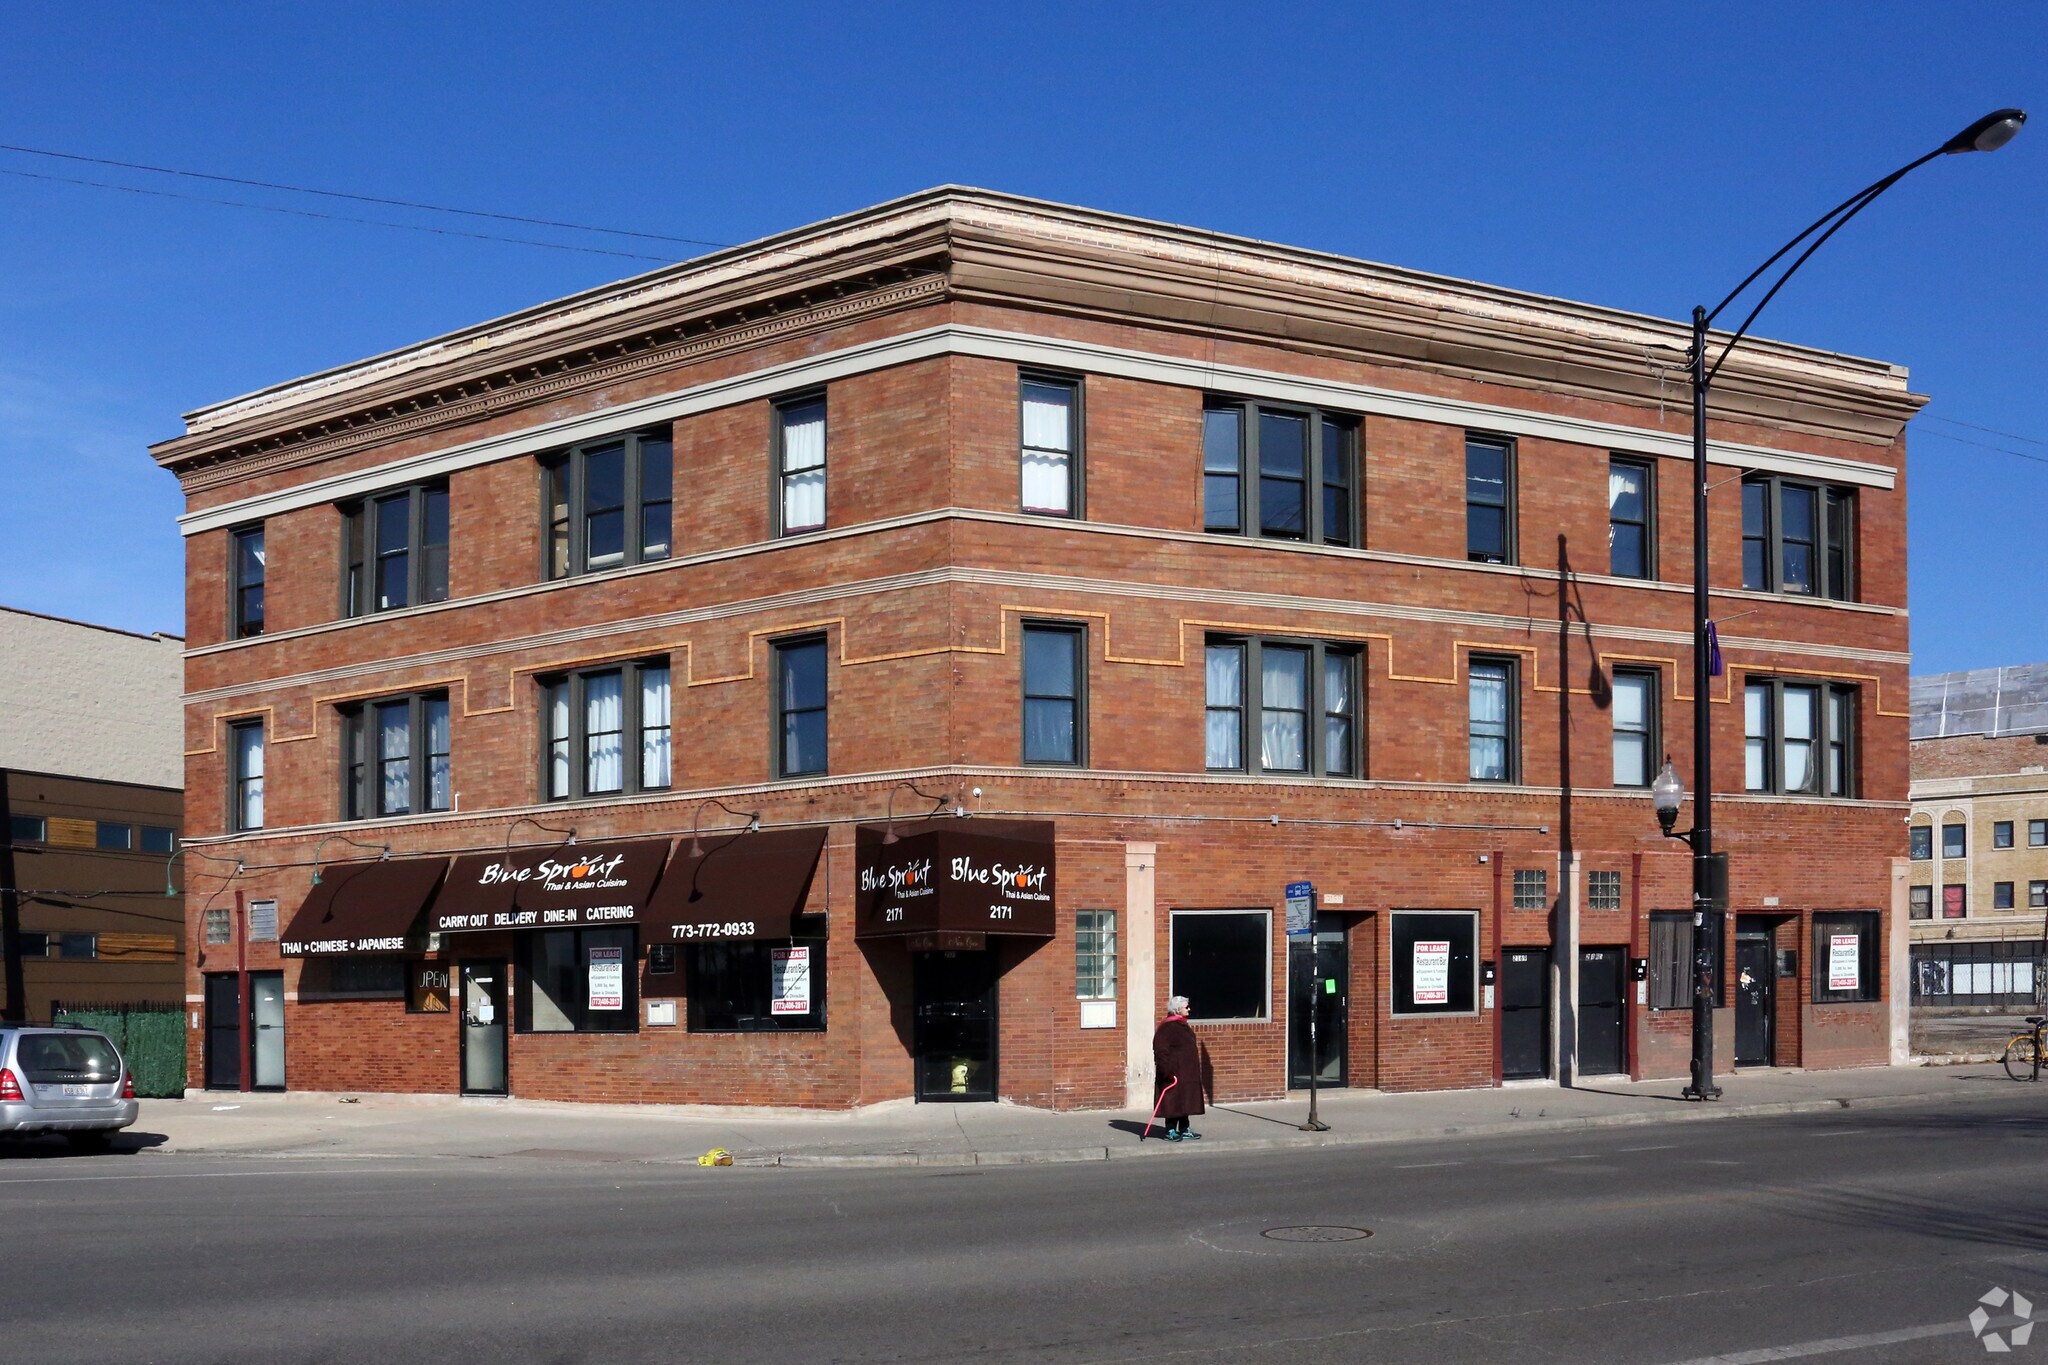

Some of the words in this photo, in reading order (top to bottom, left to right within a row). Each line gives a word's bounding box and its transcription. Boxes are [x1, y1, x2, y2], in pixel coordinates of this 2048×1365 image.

[478, 863, 532, 885] Blue
[533, 854, 624, 889] Sprout
[861, 866, 886, 891] Blue
[888, 858, 932, 896] Sprout
[950, 856, 990, 884] Blue
[991, 863, 1047, 896] Sprout
[546, 882, 565, 891] Thai
[565, 882, 570, 890] &
[571, 881, 595, 890] Asian
[596, 879, 628, 888] Cuisine
[897, 891, 905, 899] Thai
[909, 889, 919, 897] Asian
[920, 887, 934, 896] Cuisine
[1005, 890, 1016, 898] Thai
[1016, 891, 1020, 899] &
[1020, 892, 1033, 900] Asian
[1034, 893, 1050, 901] Cuisine
[439, 915, 468, 929] CARRY
[470, 914, 488, 927] OUT
[494, 911, 537, 925] DELIVERY
[544, 909, 577, 923] DINE-IN
[586, 906, 634, 921] CATERING
[886, 907, 903, 921] 2171
[989, 905, 1012, 919] 2171
[671, 922, 755, 938] 773-772-0933
[281, 942, 302, 954] THAI
[310, 940, 348, 953] CHINESE
[357, 937, 404, 950] JAPANESE
[603, 950, 620, 958] LEASE
[787, 950, 807, 958] LEASE
